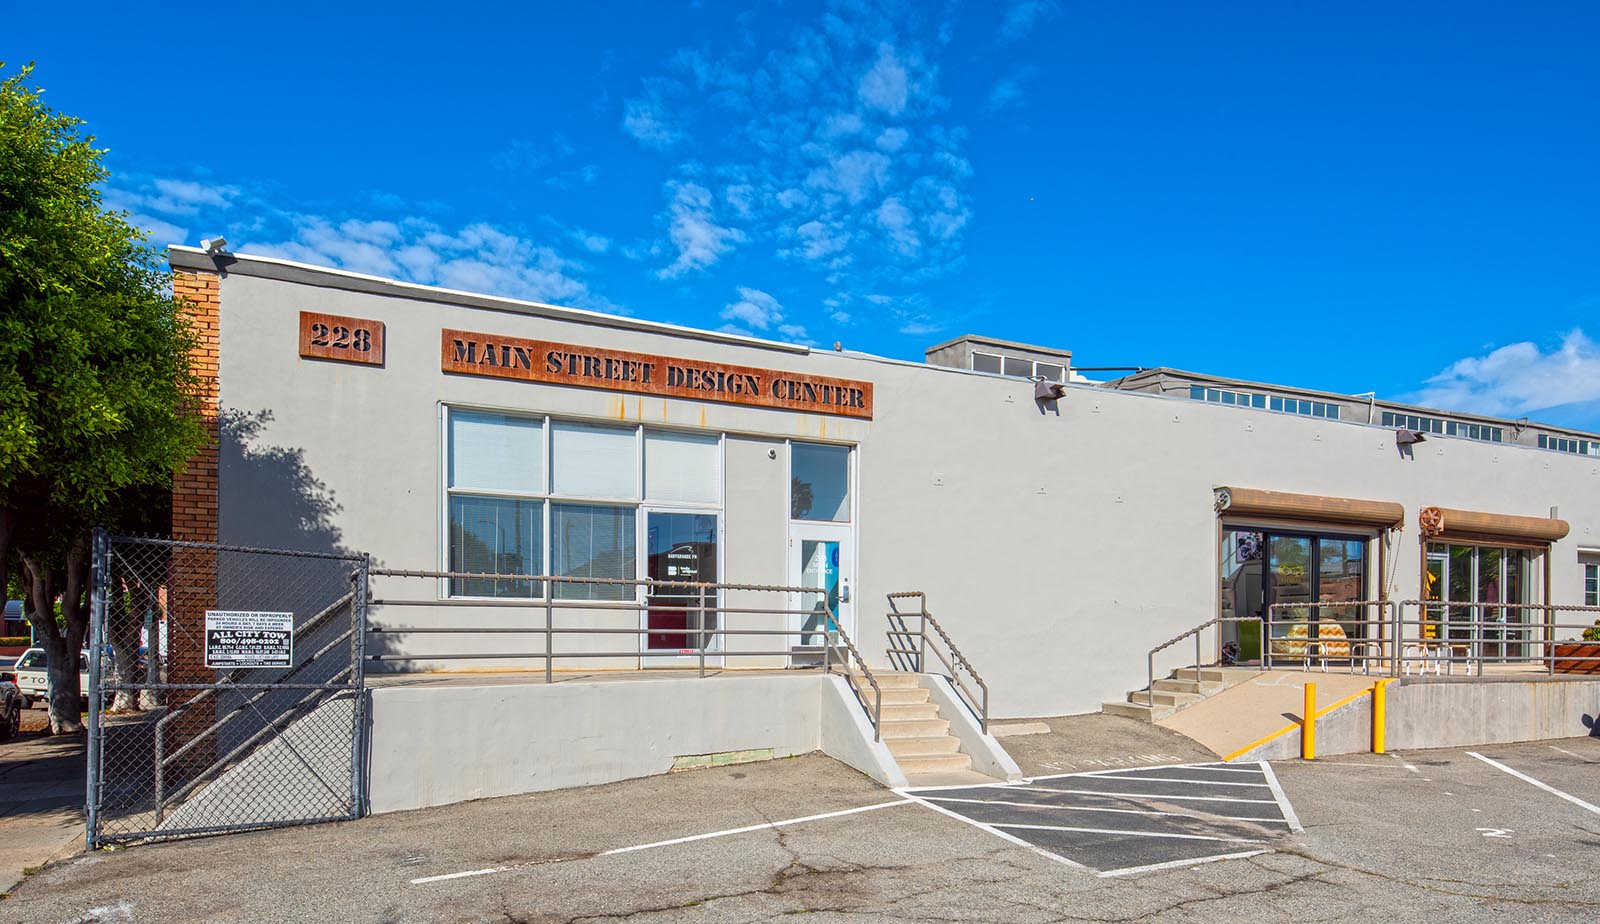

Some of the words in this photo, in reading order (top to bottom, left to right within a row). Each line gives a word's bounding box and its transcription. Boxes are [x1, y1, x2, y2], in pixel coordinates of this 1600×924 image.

[311, 323, 372, 352] 228
[452, 339, 533, 370] MAIN
[546, 351, 656, 384] STREET
[667, 365, 761, 396] DESIGN
[772, 378, 865, 409] CENTER
[212, 631, 234, 639] ALL
[263, 631, 287, 639] TOW
